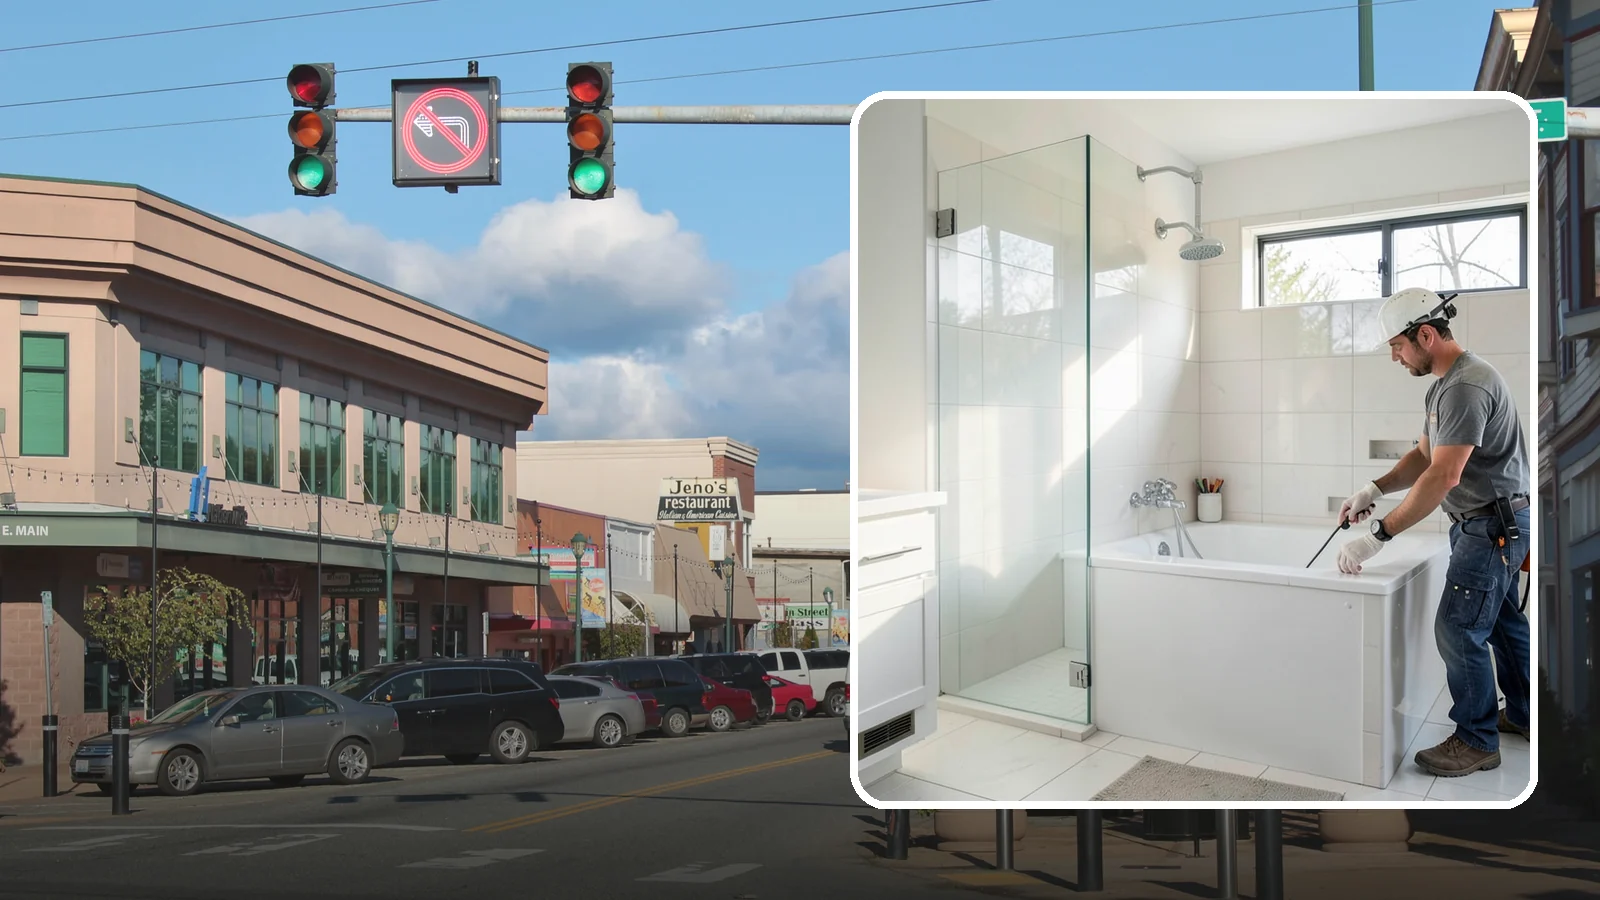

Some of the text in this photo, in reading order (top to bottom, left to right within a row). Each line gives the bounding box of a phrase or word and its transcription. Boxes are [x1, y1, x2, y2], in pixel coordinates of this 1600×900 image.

[670, 480, 727, 494] Jeno's
[665, 496, 731, 509] restaurant
[659, 510, 681, 519] Italian
[686, 510, 714, 519] American
[715, 509, 737, 519] Cuisine
[2, 525, 49, 536] E. MAIN
[797, 607, 828, 617] Street
[791, 619, 824, 627] lass
